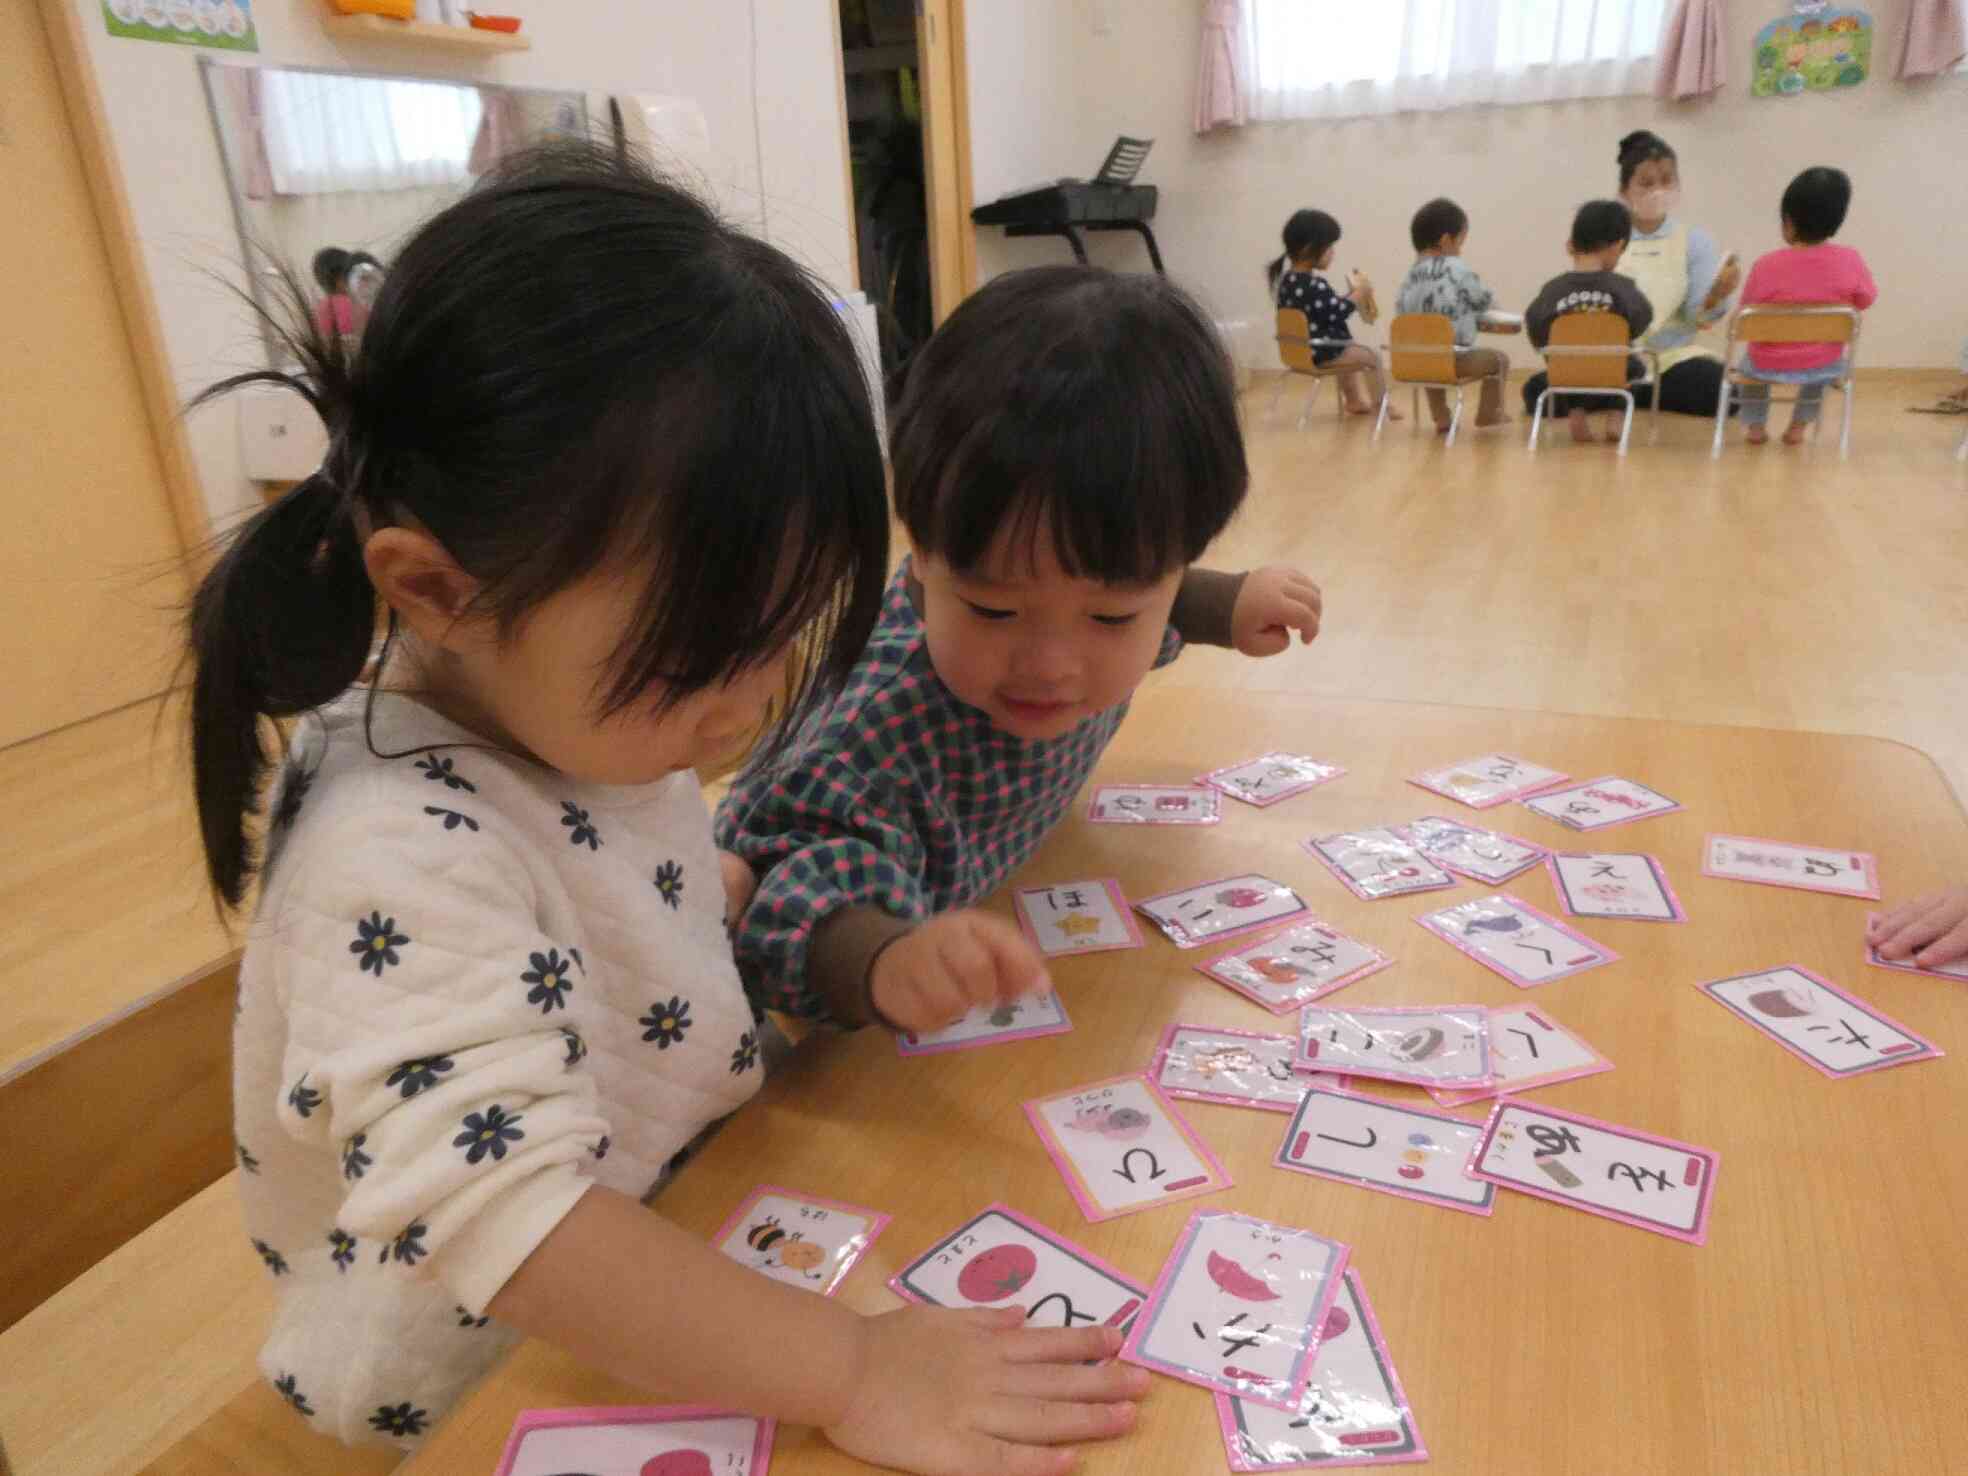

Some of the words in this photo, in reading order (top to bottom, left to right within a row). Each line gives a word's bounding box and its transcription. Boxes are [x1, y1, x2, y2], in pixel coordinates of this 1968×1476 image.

[1178, 899, 1213, 921] い
[1290, 940, 1337, 966] み
[1516, 943, 1554, 966] く
[1507, 1028, 1539, 1059] へ
[1806, 1018, 1871, 1050] た
[1317, 1127, 1377, 1149] し
[1112, 1148, 1167, 1184] ひ
[1608, 1162, 1676, 1193] を
[800, 1206, 830, 1221] はち
[936, 1234, 979, 1266] とまと
[1026, 1292, 1097, 1327] と
[1192, 1312, 1272, 1358] か
